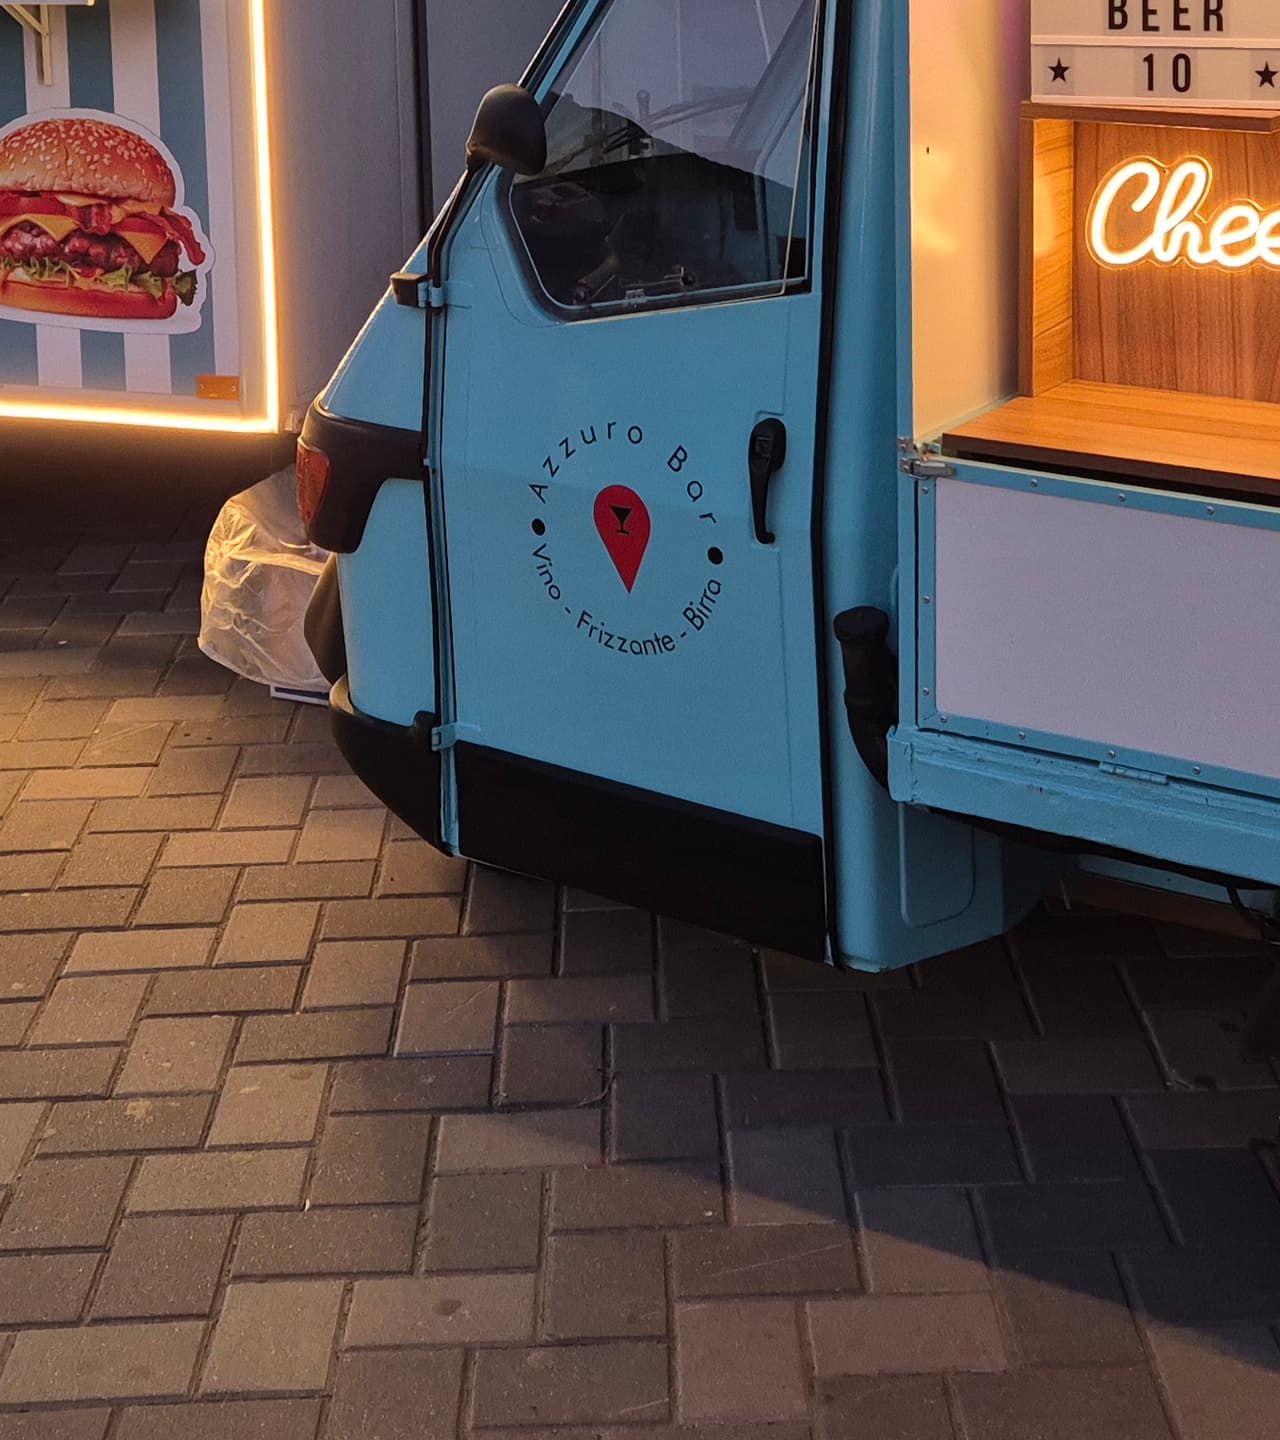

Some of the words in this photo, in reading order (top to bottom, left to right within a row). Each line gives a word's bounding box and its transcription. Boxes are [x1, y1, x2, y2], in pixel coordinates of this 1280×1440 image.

[1143, 53, 1192, 93] 10
[528, 421, 644, 504] Azzuro
[667, 445, 717, 524] Bar
[532, 543, 562, 600] Vino
[576, 611, 677, 656] Frizzante
[682, 578, 723, 631] Birra
